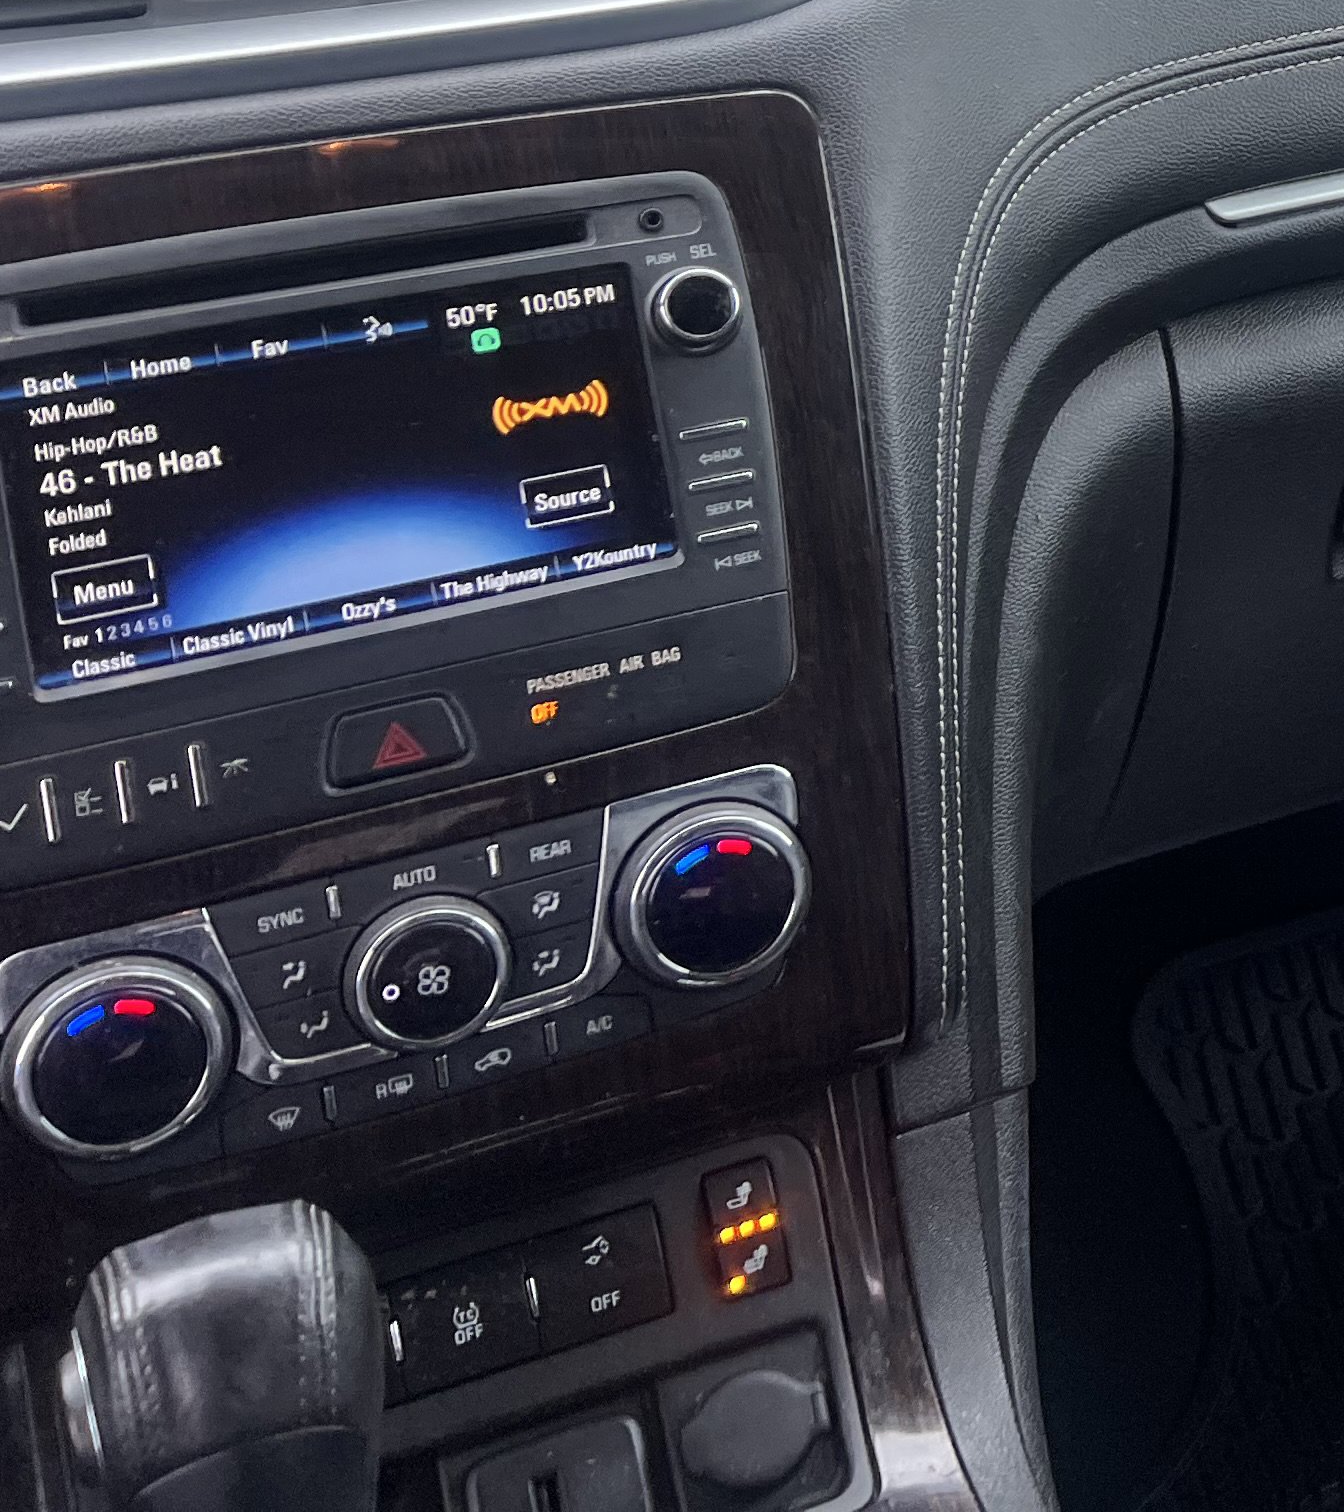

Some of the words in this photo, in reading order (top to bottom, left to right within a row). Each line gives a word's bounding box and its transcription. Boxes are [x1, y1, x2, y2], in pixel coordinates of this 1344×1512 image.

[645, 251, 678, 267] PUSH
[689, 243, 718, 260] SEL
[519, 288, 581, 316] 10:05
[584, 284, 616, 306] PM
[445, 303, 498, 329] 50°F
[250, 339, 289, 360] Fav
[130, 355, 193, 380] Home
[22, 370, 78, 399] Back
[28, 404, 61, 427] XM
[64, 397, 116, 421] Audio
[34, 424, 159, 463] Hip-Hop/R&B
[714, 446, 744, 463] BACK
[39, 468, 78, 497] 46
[100, 458, 153, 487] The
[158, 445, 223, 478] Heat
[534, 486, 602, 513] Source
[44, 499, 113, 528] Kehlani
[48, 528, 107, 556] Folded
[572, 542, 657, 572] Y2Kountry
[73, 578, 135, 606] Menu
[439, 579, 474, 601] The
[476, 563, 548, 595] Highway
[341, 596, 398, 623] Ozzy's
[63, 631, 88, 651] Fav
[182, 627, 246, 656] Classic
[247, 615, 295, 644] Vinyl
[71, 651, 137, 680] Classic
[526, 662, 610, 695] PASSENGER
[619, 655, 645, 674] AIR
[651, 646, 681, 667] BAG
[530, 700, 559, 724] OFF
[529, 839, 572, 863] REAR
[393, 865, 437, 891] AUTO
[257, 907, 305, 933] SYNC
[586, 1015, 614, 1035] A/C
[590, 1289, 621, 1313] OFF
[454, 1322, 484, 1346] OFF
